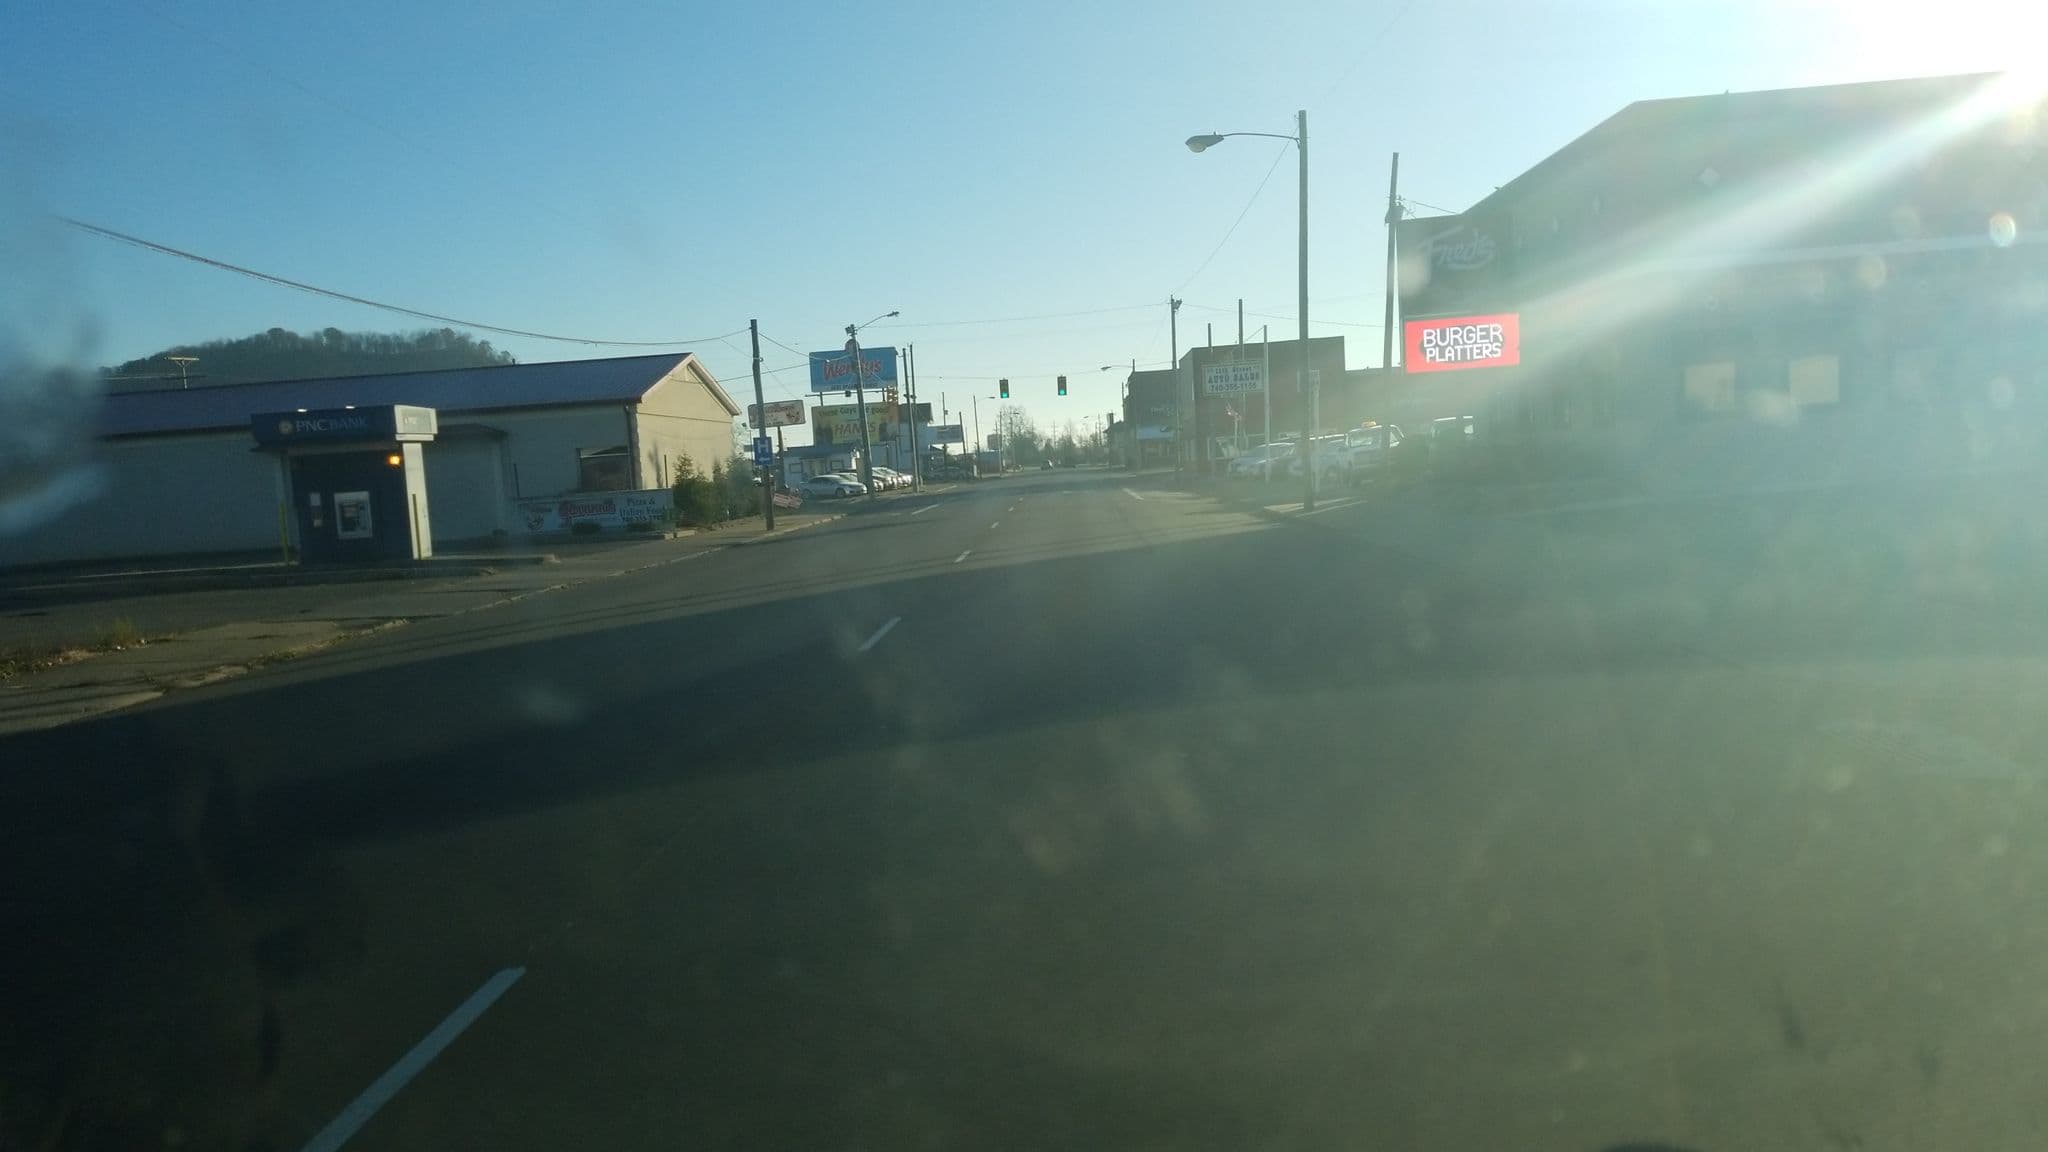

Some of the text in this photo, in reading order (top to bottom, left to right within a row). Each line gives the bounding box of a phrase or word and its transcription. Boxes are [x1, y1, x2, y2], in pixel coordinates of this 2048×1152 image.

[1423, 323, 1504, 348] BURGER
[1425, 342, 1502, 363] PLATTERS
[1208, 375, 1230, 384] AUTO
[330, 415, 368, 432] BANK
